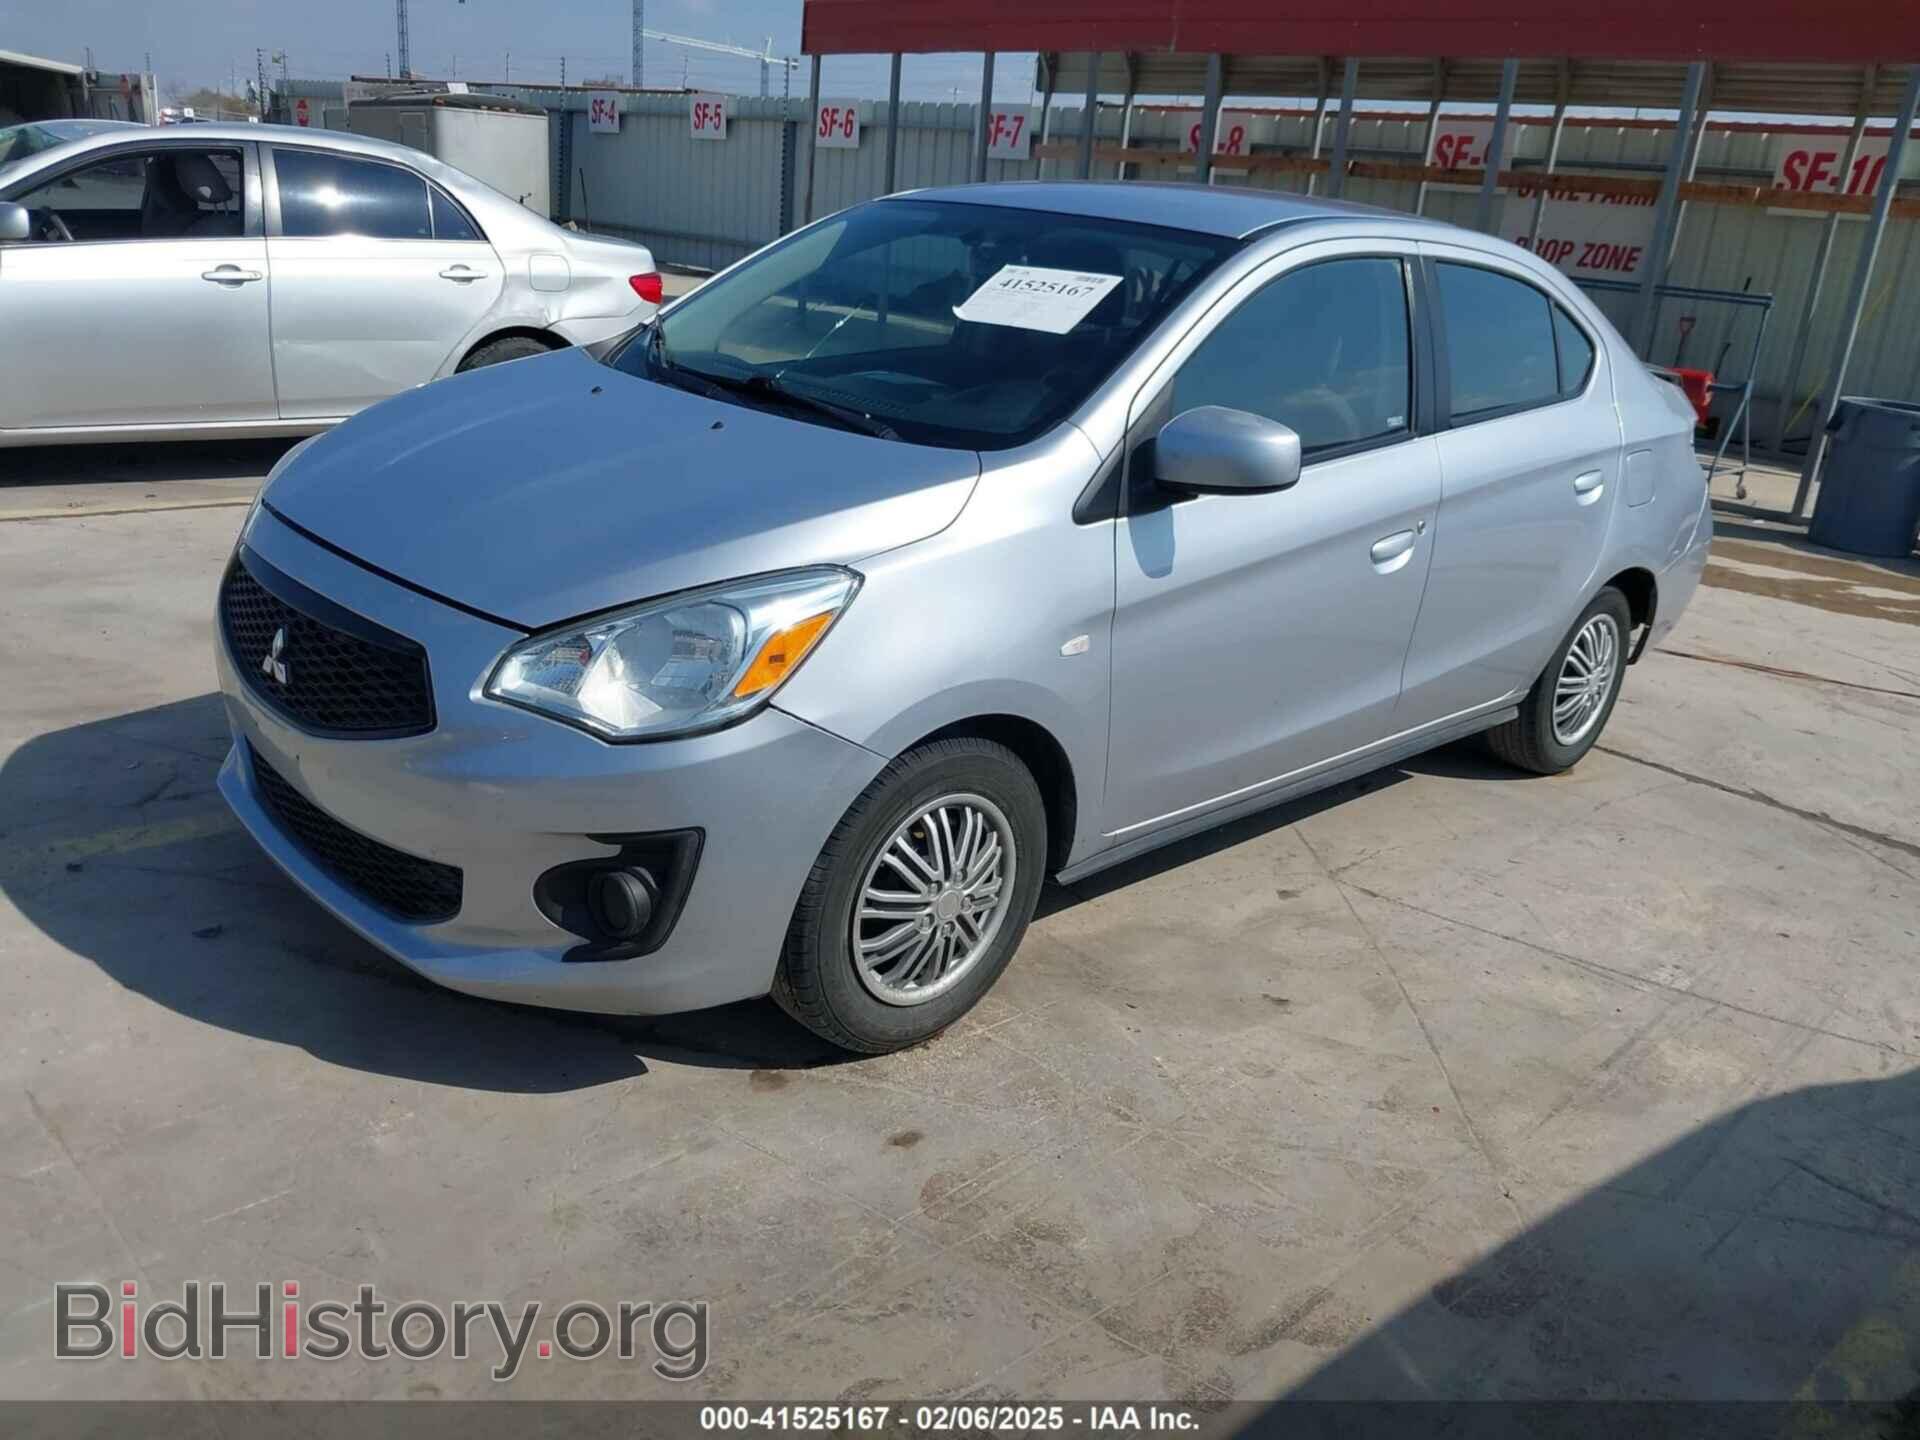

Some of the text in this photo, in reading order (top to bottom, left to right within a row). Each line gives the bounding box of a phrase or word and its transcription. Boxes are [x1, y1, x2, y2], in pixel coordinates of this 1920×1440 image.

[591, 99, 616, 125] SF-4
[694, 102, 722, 131] SF-5
[818, 107, 856, 139] SF-6
[1187, 123, 1245, 154] S-8
[1431, 133, 1489, 170] SF-
[1575, 242, 1642, 273] ZONE
[999, 277, 1095, 298] 41525167
